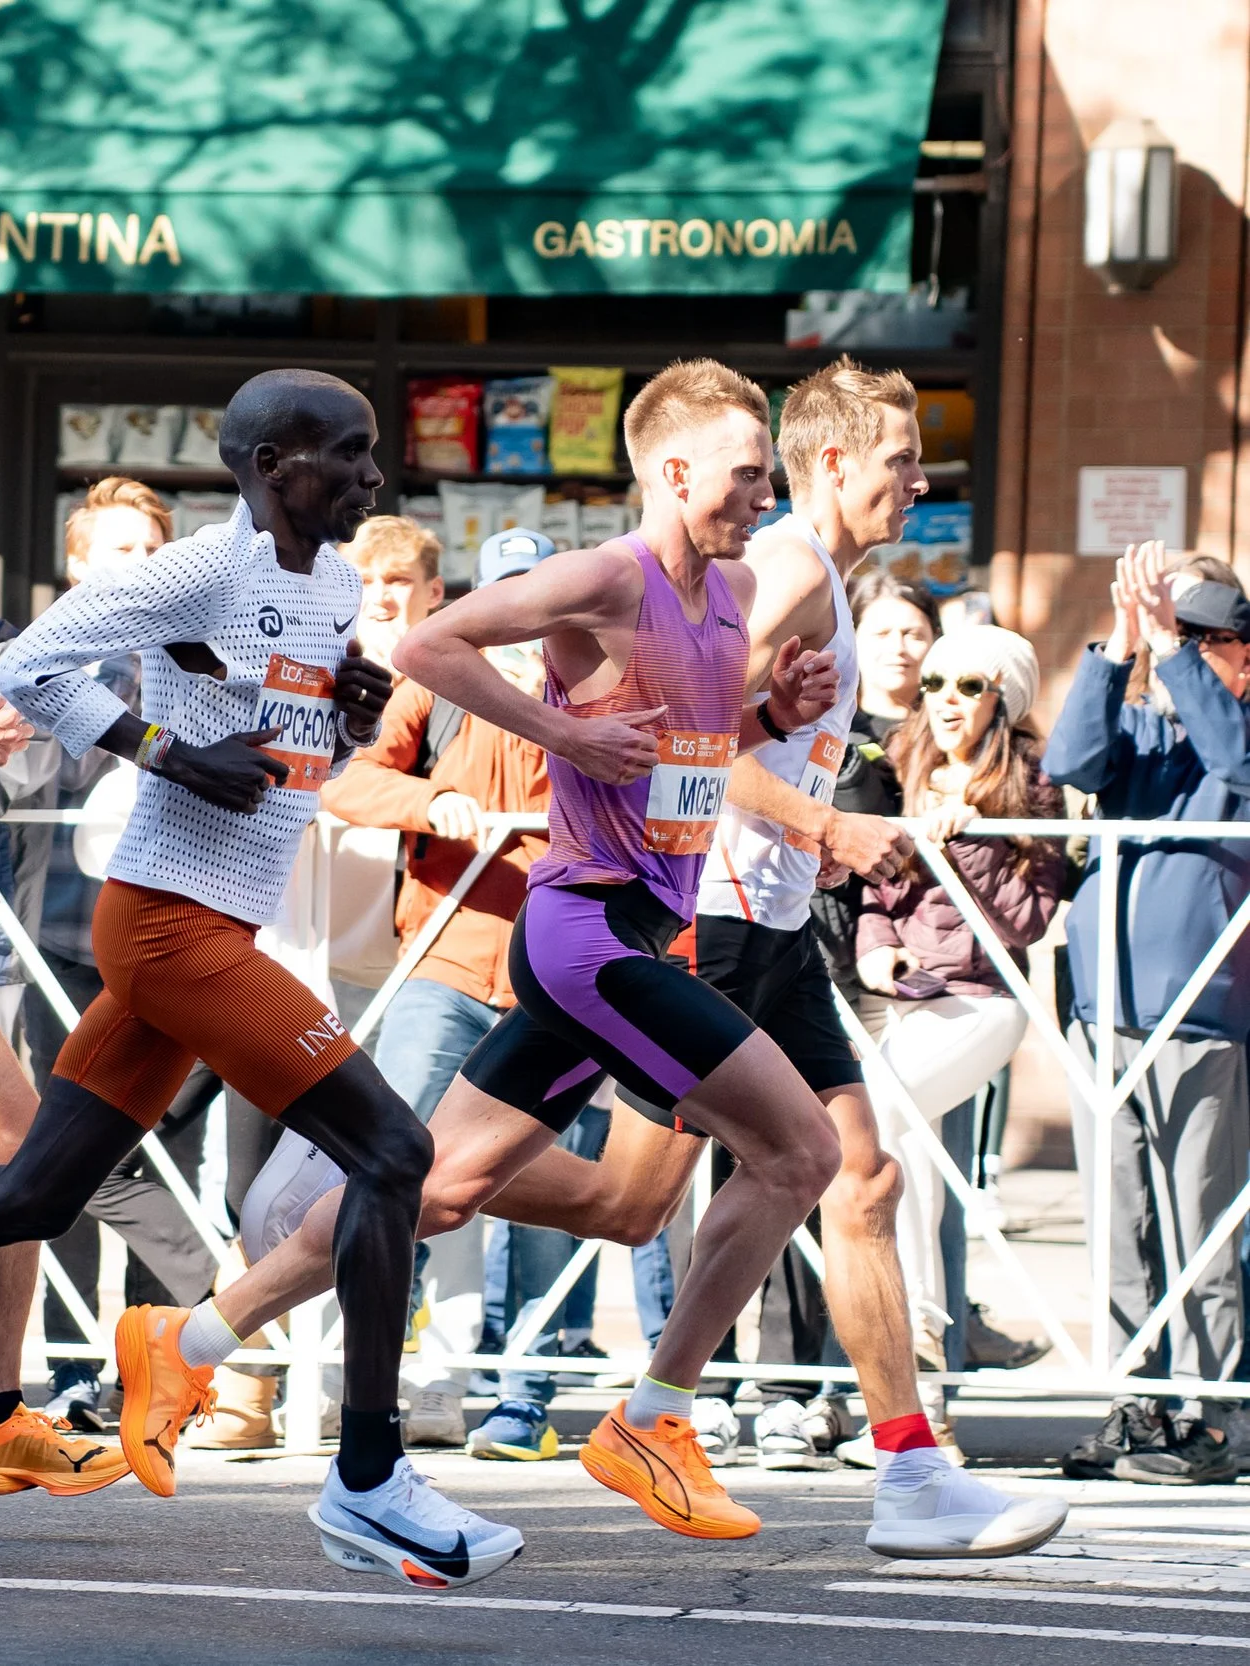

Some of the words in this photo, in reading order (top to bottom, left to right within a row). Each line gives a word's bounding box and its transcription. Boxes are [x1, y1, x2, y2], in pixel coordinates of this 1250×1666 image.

[533, 217, 858, 260] GASTRONOMIA
[258, 699, 339, 750] KIPCHOG
[672, 735, 696, 757] tcs
[677, 776, 726, 815] MOEN
